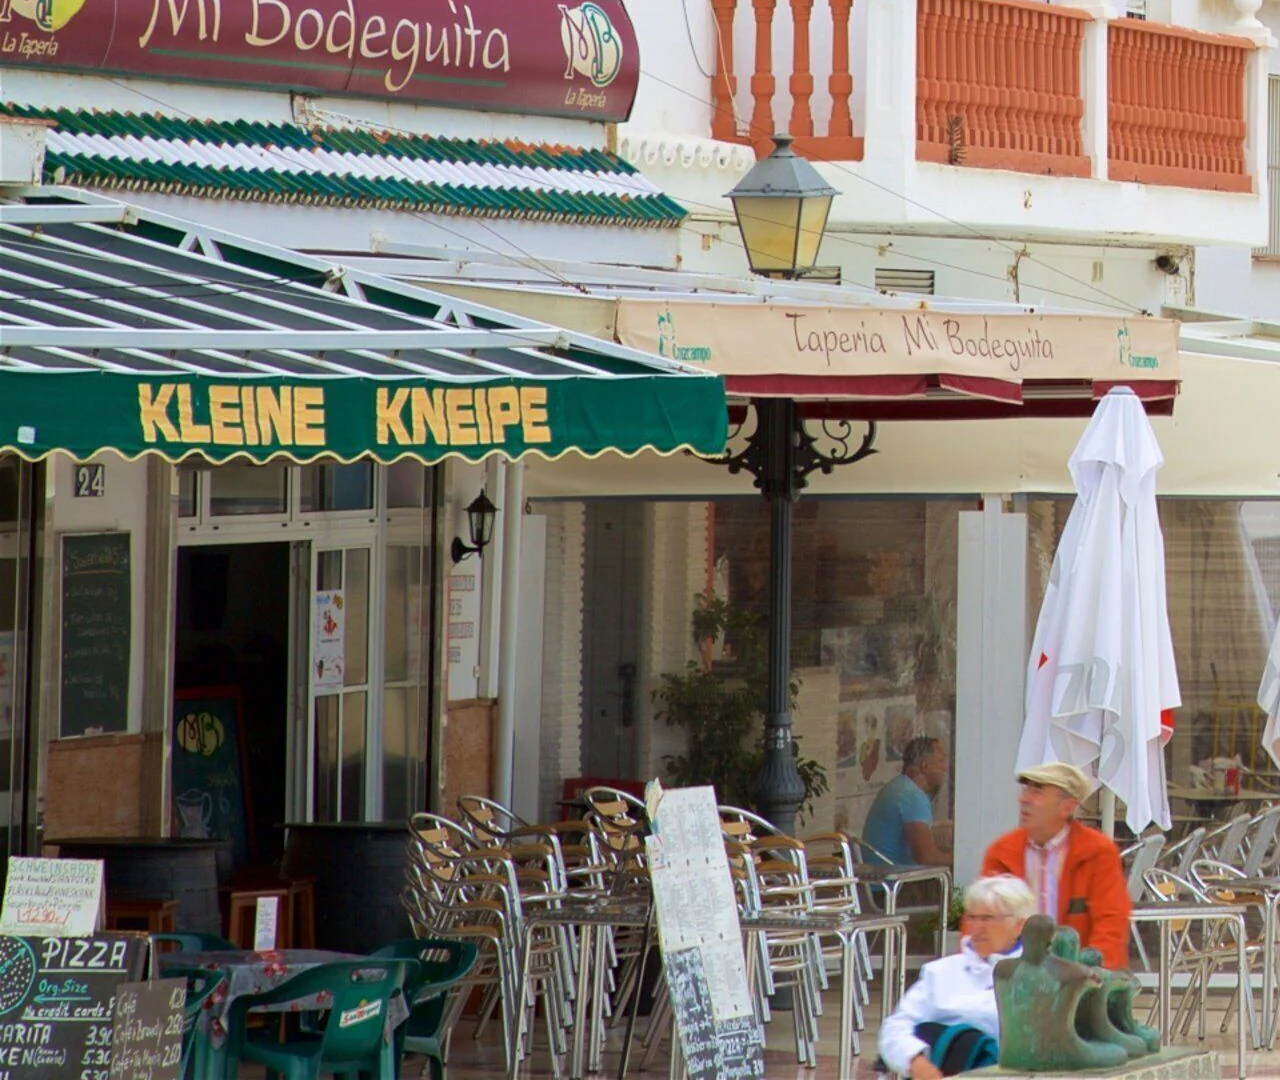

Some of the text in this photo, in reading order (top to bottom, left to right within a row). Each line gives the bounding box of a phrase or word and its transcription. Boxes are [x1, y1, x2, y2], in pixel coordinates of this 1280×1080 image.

[2, 33, 16, 53] La
[564, 88, 577, 106] La
[901, 314, 938, 356] Mi
[943, 318, 1055, 371] Bodeguita
[138, 383, 551, 446] KLEINE KNEIPE
[78, 465, 105, 496] 24
[42, 937, 127, 969] PIZZA
[38, 1001, 69, 1018] credit
[0, 1023, 52, 1045] ARITA
